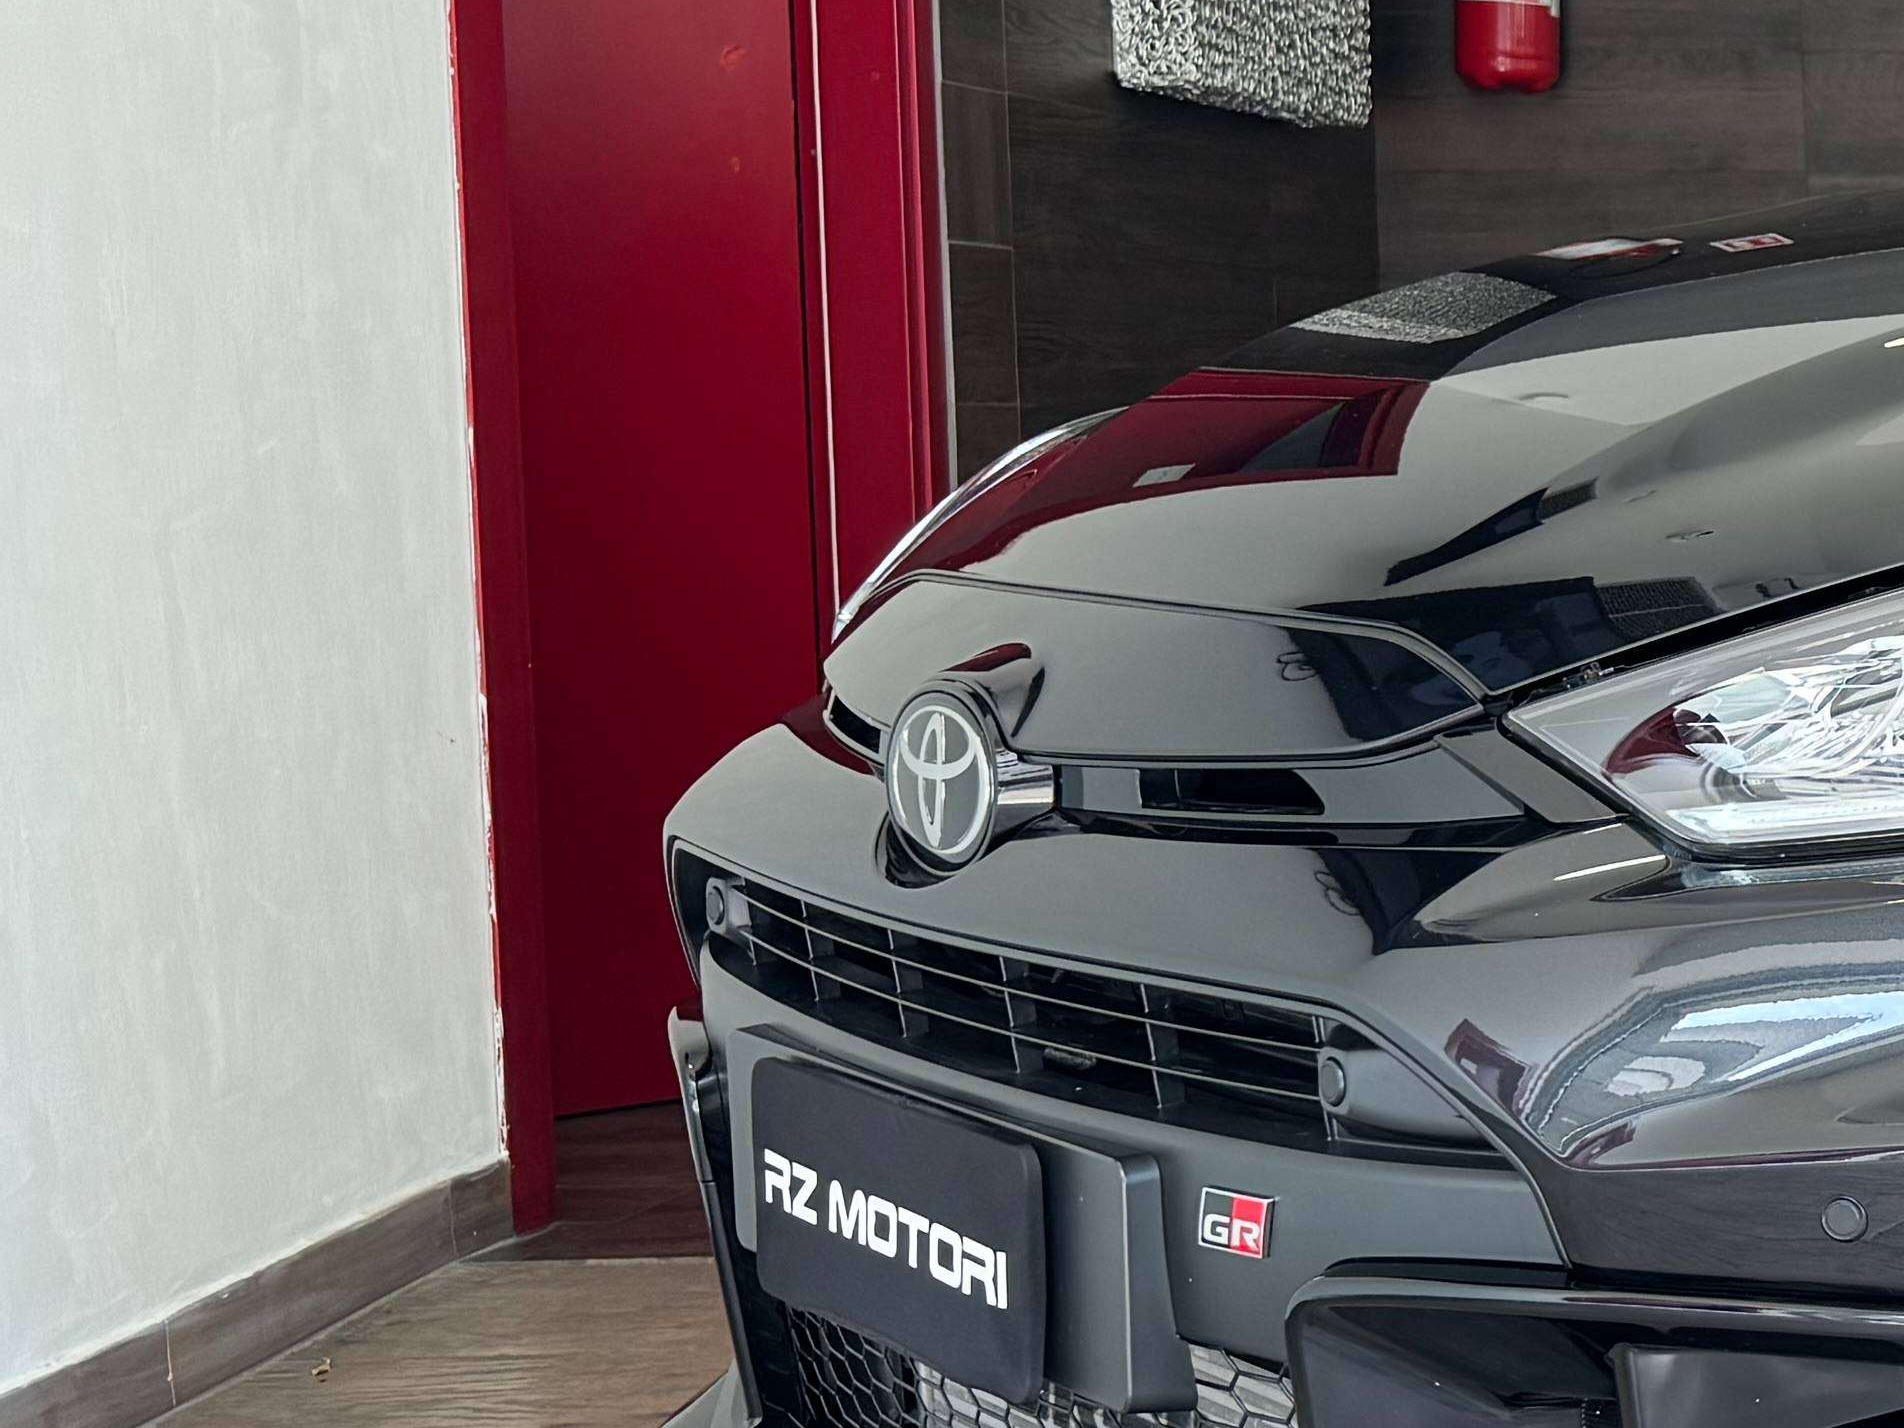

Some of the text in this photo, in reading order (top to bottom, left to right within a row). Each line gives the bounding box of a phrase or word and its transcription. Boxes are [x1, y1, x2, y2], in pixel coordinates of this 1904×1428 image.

[764, 1148, 1008, 1309] RZ MOTORI
[1203, 1213, 1261, 1252] GR
